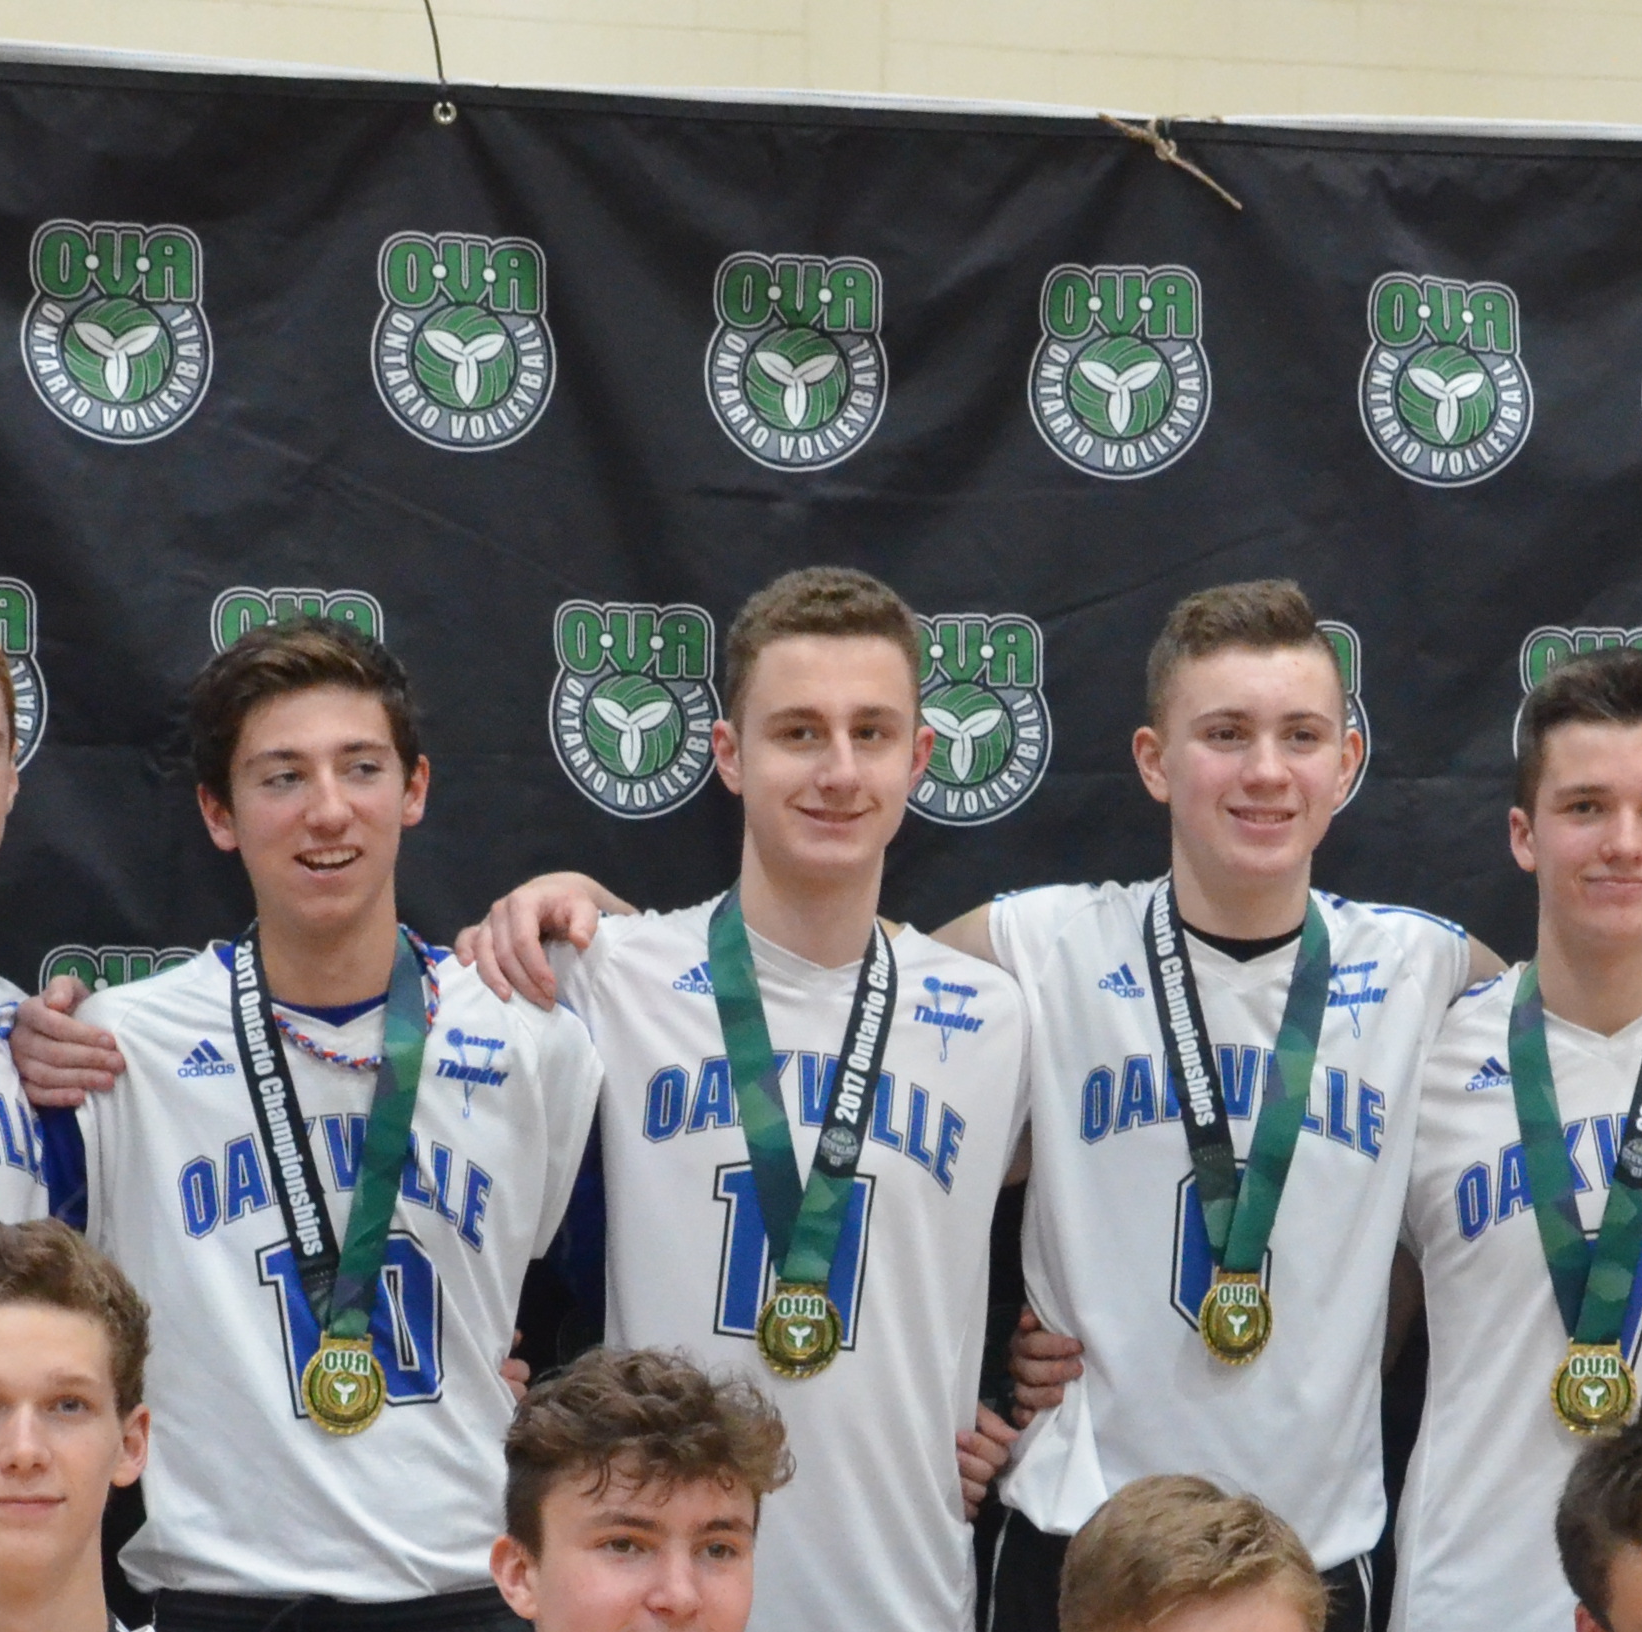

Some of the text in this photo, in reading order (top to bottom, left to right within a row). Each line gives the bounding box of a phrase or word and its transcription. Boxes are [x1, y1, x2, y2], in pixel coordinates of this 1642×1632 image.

[35, 228, 195, 302] OVA
[384, 239, 538, 313] OVA
[718, 259, 871, 332] OVA
[1042, 271, 1195, 343] OVA
[1372, 280, 1517, 352] OVA
[32, 302, 202, 432] ONTARIO VOLLEYBALL
[380, 313, 546, 441] ONTARIO VOLLEYBALL
[714, 332, 878, 460] ONTARIO VOLLEYBALL
[1038, 343, 1202, 469] ONTARIO VOLLEYBALL
[1369, 352, 1524, 478] ONTARIO VOLLEYBALL
[562, 608, 706, 681] OVA
[559, 681, 712, 808] ONTARIO VOLLEYBALL
[847, 992, 887, 1069] Ontario
[913, 1003, 984, 1034] Thunder
[1159, 953, 1216, 1127] Championships
[177, 1061, 235, 1078] adidas
[234, 940, 322, 1256] 2017 Ontario Championships
[435, 1058, 510, 1088] Thunder
[835, 1064, 873, 1124] 2017
[643, 1050, 966, 1195] OAVLLE
[178, 1113, 493, 1253] OAVLLE
[255, 1229, 444, 1419] 10
[775, 1295, 826, 1320] OVA
[1217, 1283, 1259, 1307] OVA
[322, 1349, 372, 1374] OVA
[1569, 1354, 1619, 1379] OVA
